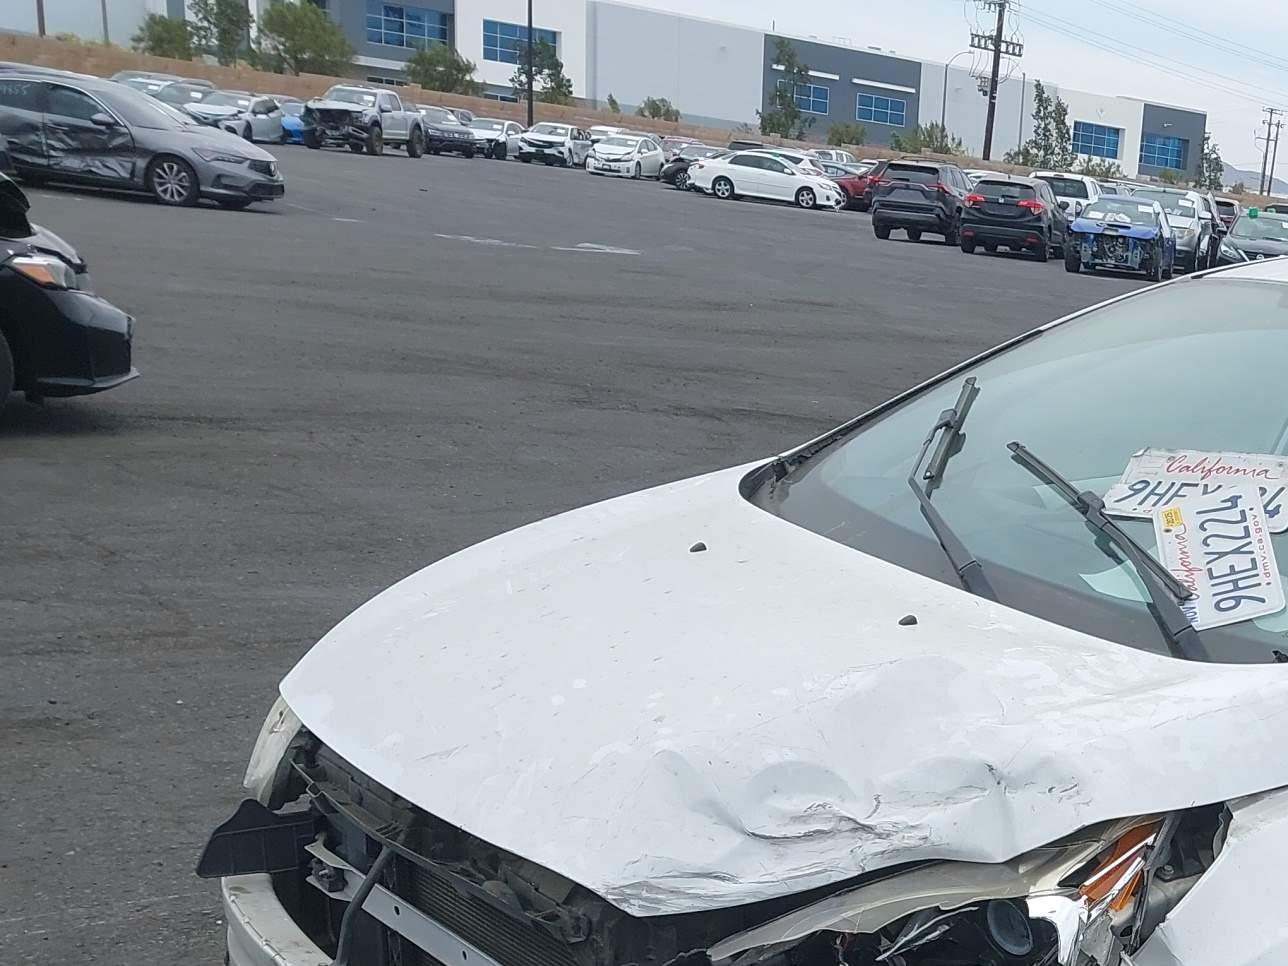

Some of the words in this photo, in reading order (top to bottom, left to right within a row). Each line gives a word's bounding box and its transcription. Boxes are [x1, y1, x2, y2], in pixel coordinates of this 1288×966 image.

[1166, 455, 1280, 480] California
[1195, 495, 1266, 613] 9HEX224
[1251, 514, 1271, 579] dmv.ca.gov
